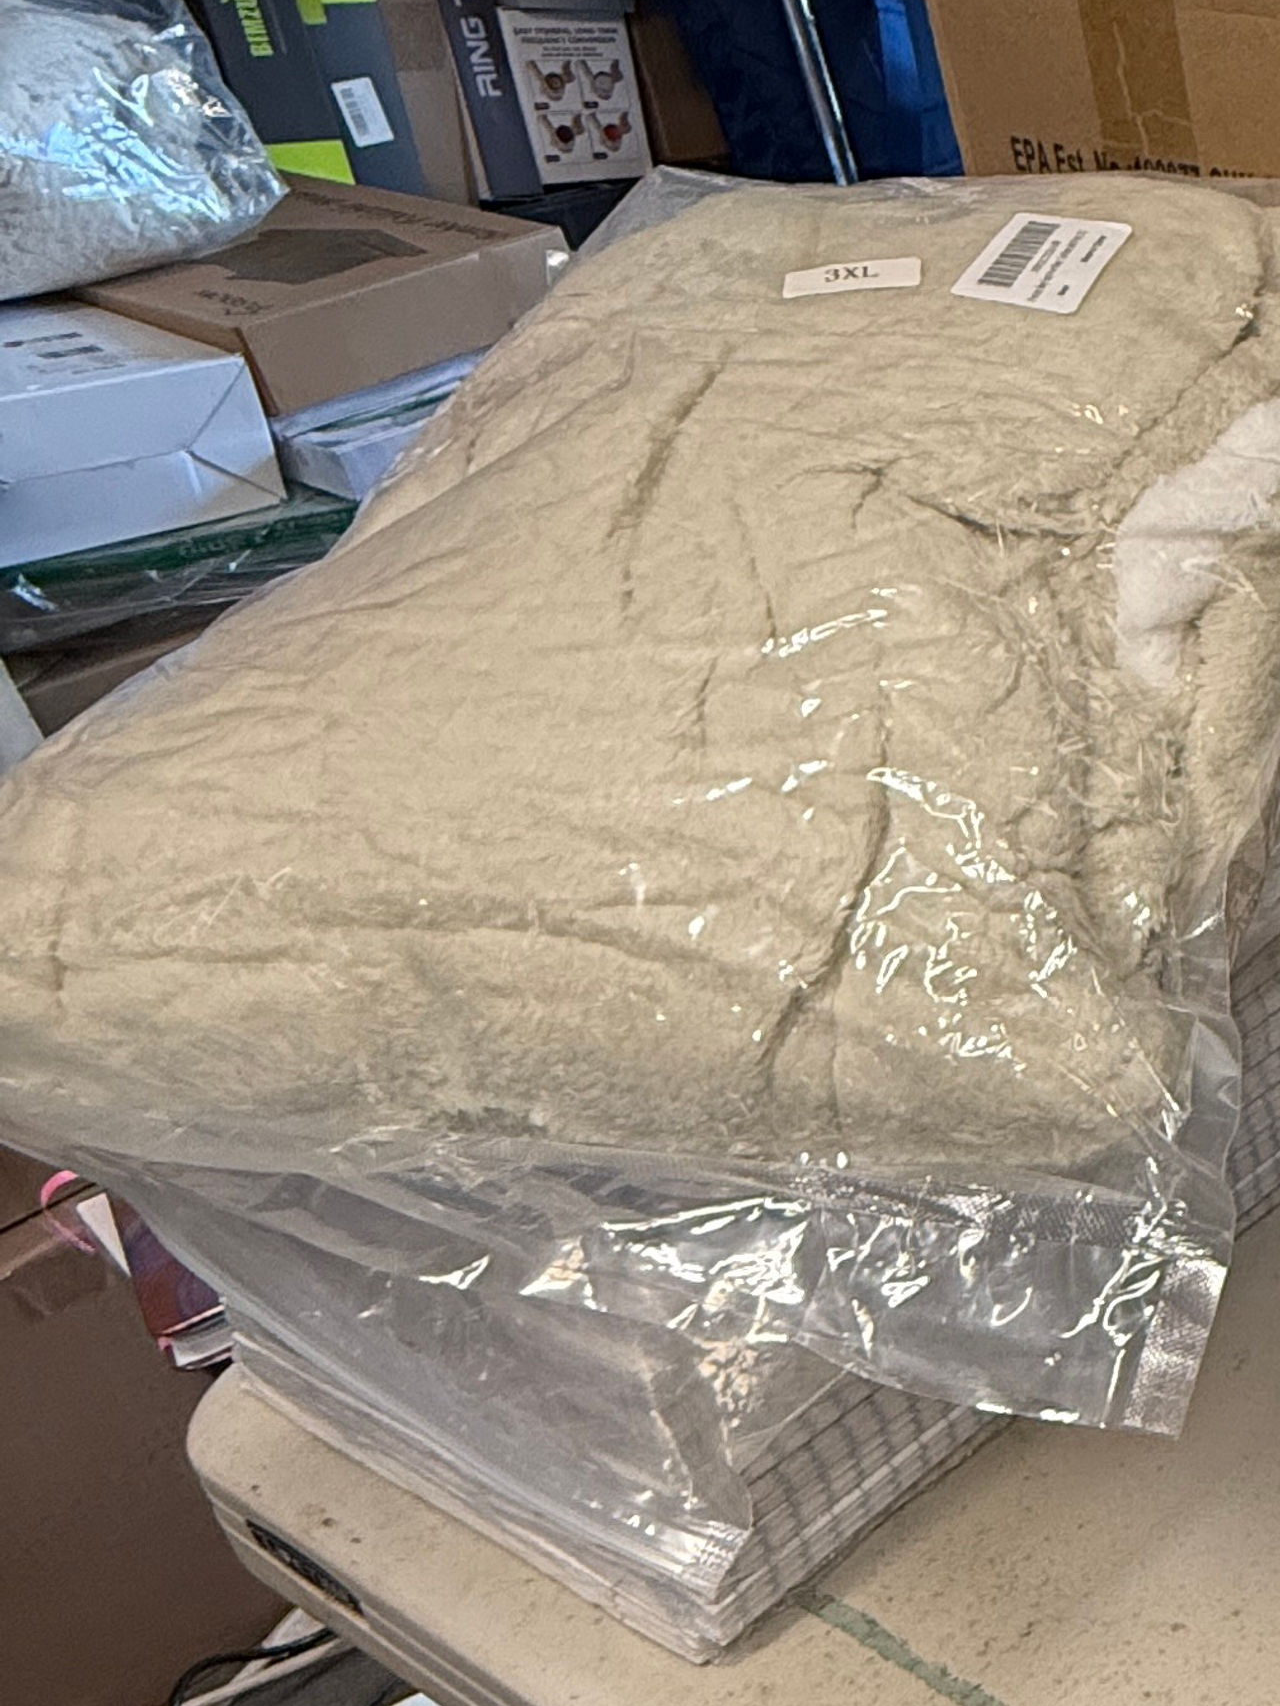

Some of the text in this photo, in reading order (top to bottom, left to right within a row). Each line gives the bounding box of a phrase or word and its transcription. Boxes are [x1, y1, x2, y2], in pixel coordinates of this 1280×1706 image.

[460, 16, 502, 98] RING
[1010, 136, 1050, 173] EPA
[824, 265, 879, 283] 3XL
